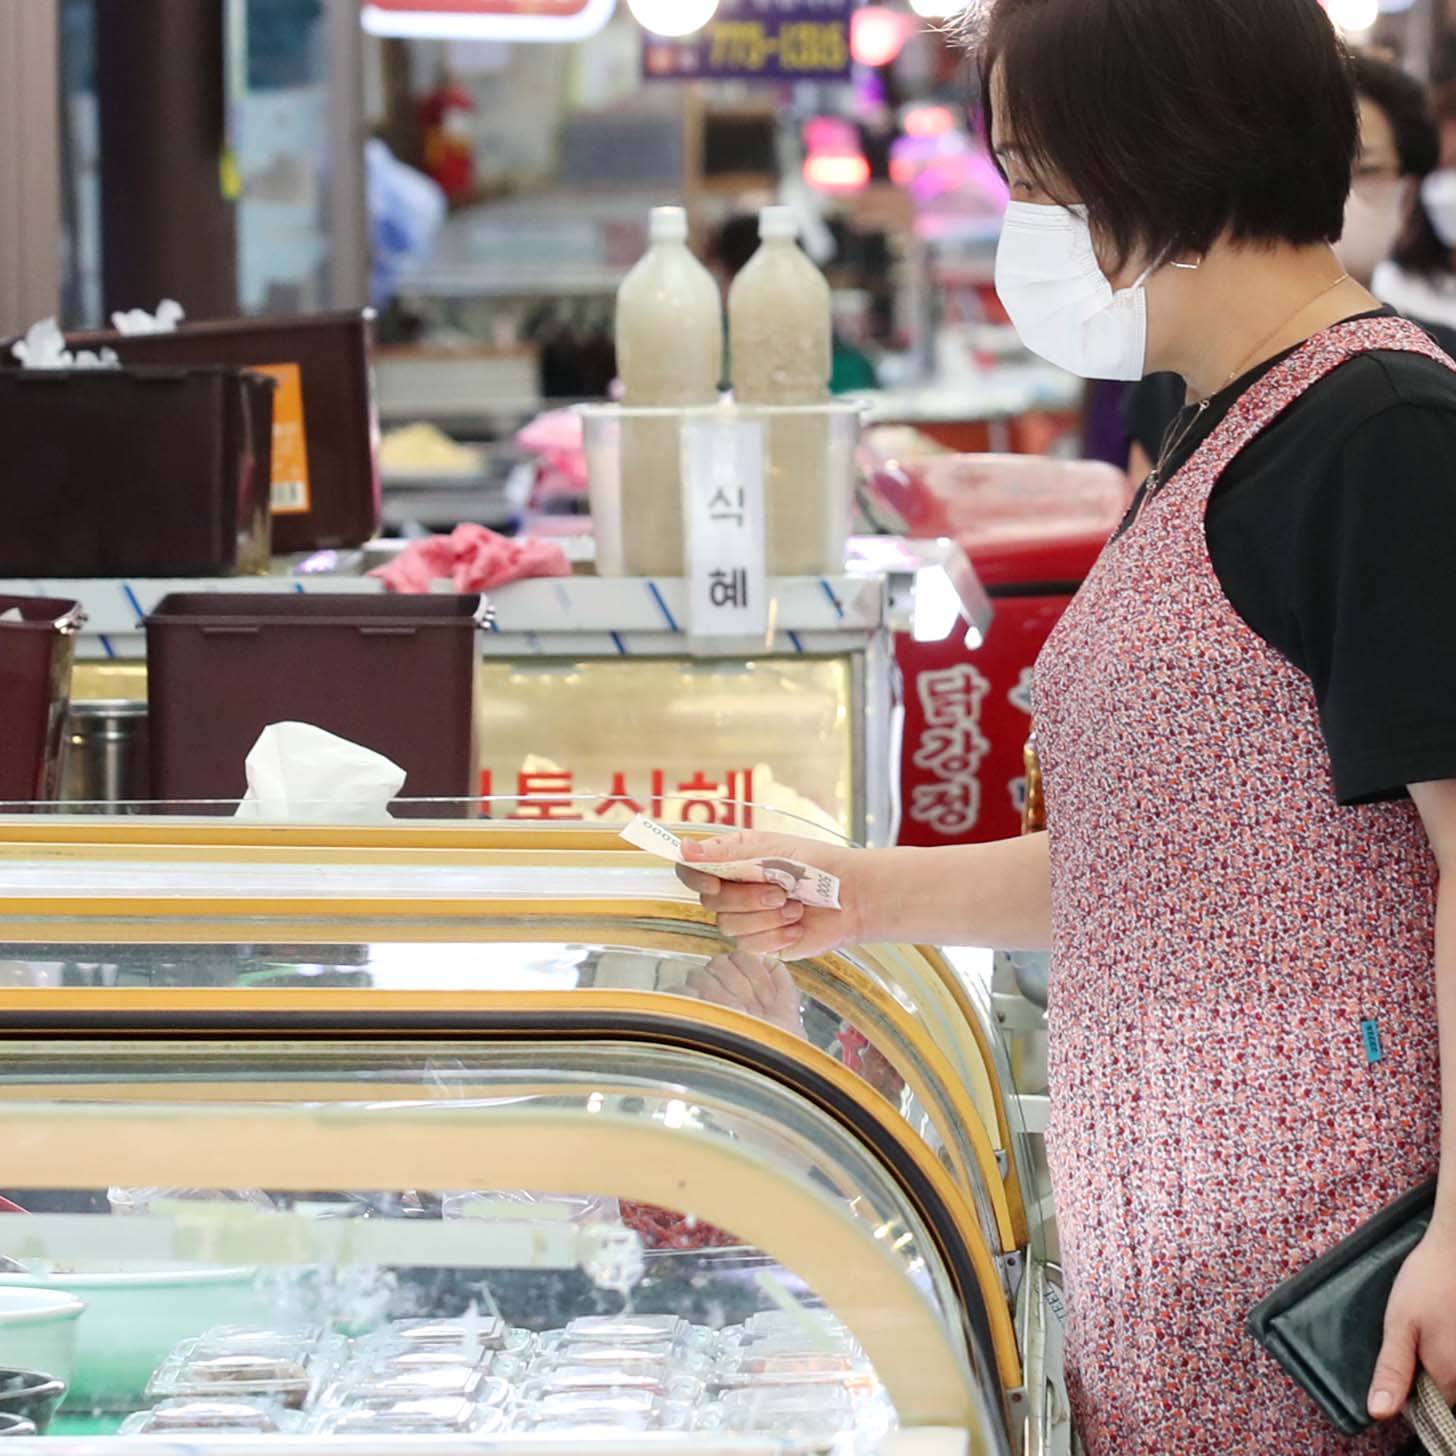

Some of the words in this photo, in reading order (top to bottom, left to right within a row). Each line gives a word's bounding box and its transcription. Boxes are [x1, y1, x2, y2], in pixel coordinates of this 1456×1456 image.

[707, 485, 749, 609] 식혜
[480, 767, 754, 830] 통식혜
[911, 663, 992, 835] 닭강정
